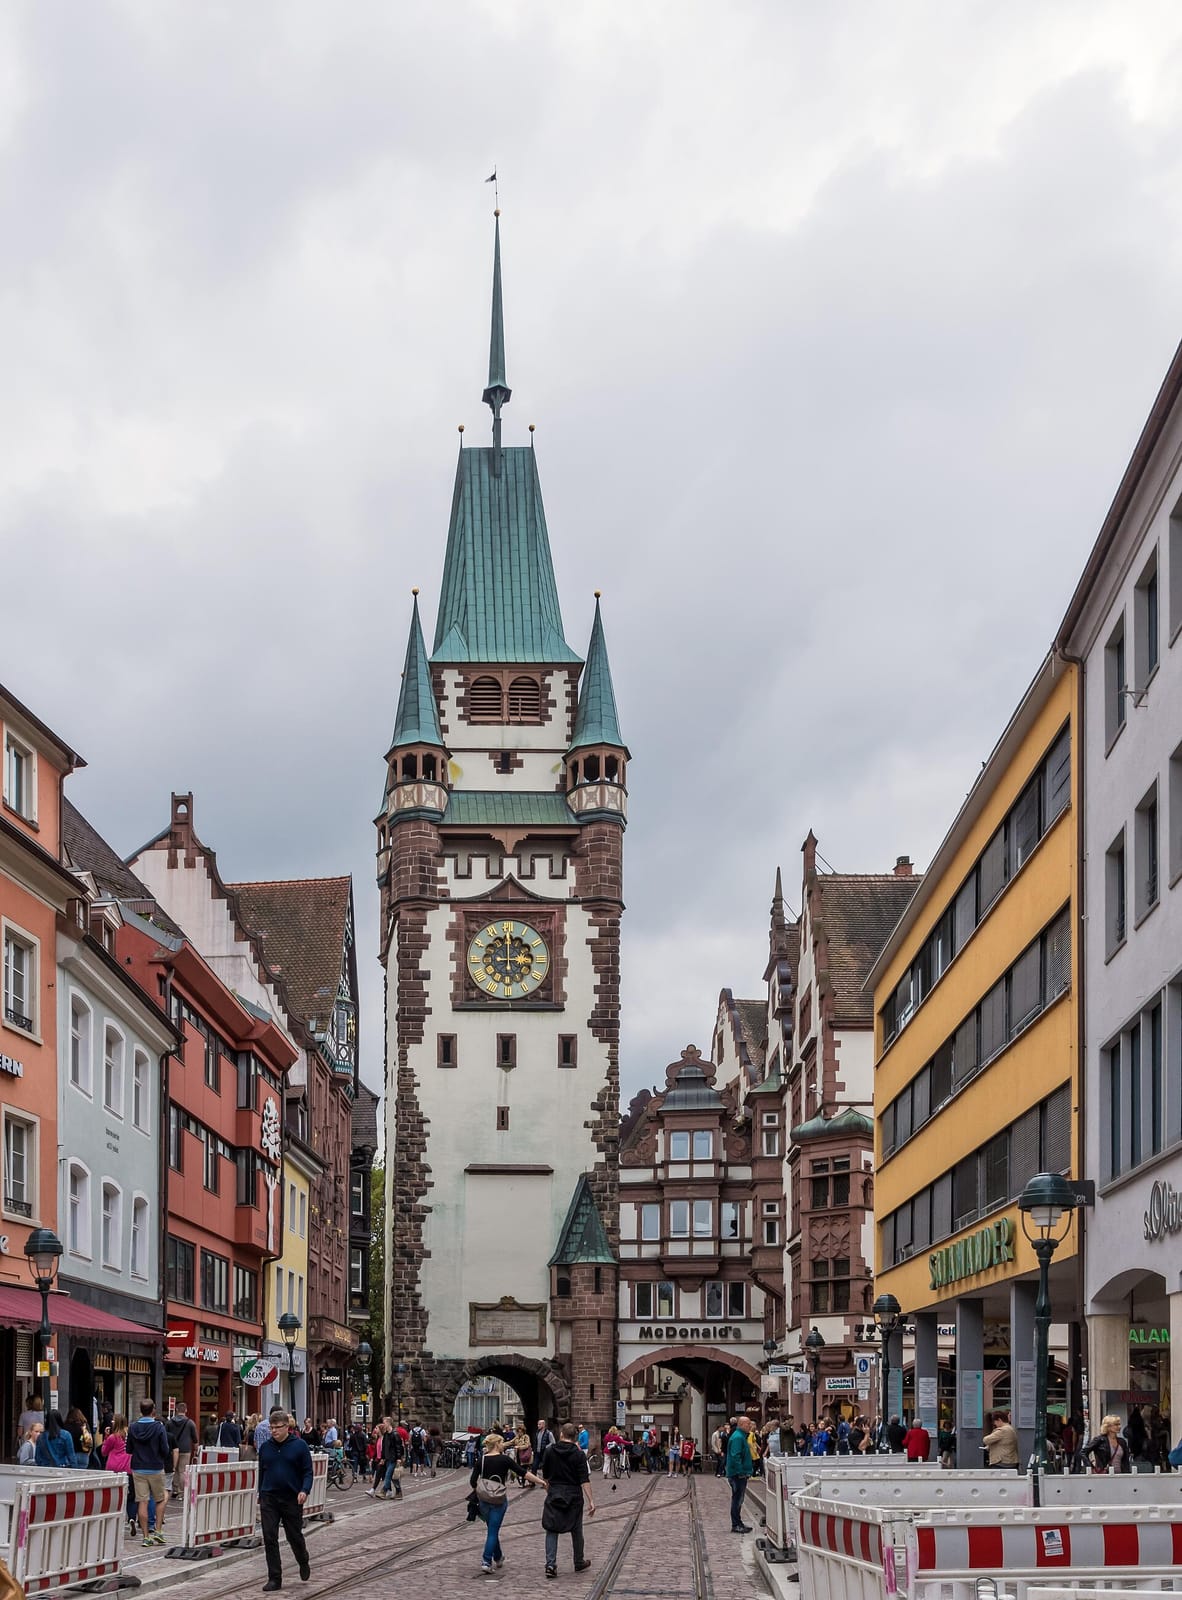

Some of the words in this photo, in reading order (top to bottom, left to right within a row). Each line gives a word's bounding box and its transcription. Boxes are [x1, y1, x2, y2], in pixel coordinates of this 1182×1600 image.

[929, 1217, 1014, 1290] SALAMANDER
[639, 1326, 742, 1339] McDonald's
[203, 1348, 219, 1362] JONES
